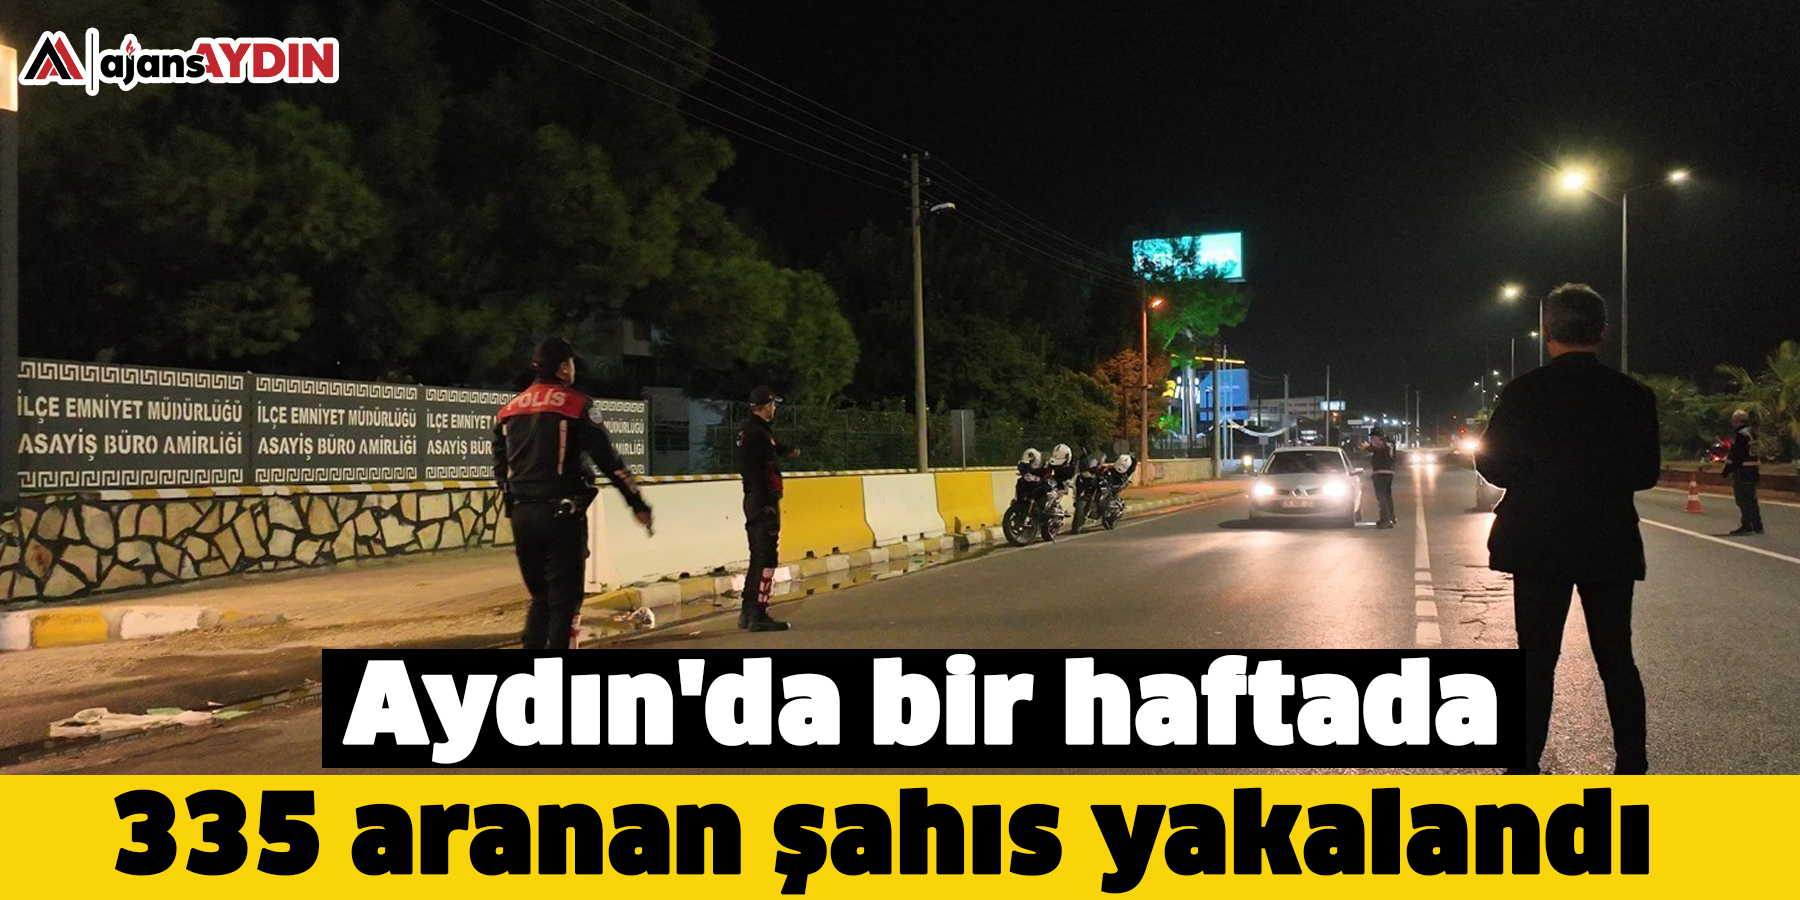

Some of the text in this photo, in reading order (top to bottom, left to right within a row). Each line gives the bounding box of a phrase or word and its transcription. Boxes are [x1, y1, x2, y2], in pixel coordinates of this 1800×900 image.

[17, 389, 243, 424] İLÇE EMNİYET MÜDÜRLÜĞÜ
[257, 400, 417, 430] İLÇE EMNİYET MÜDÜRLÜĞÜ
[426, 408, 449, 433] İLÇE
[450, 410, 492, 430] EMNİYET
[18, 428, 242, 461] ASAYİŞ BÜRO AMİRLİĞİ
[257, 432, 417, 461] ASAYİŞ BÜRO AMİRLİĞİ
[427, 436, 493, 460] ASAYİŞ BÜR
[612, 439, 645, 455] MİRLİĞİ
